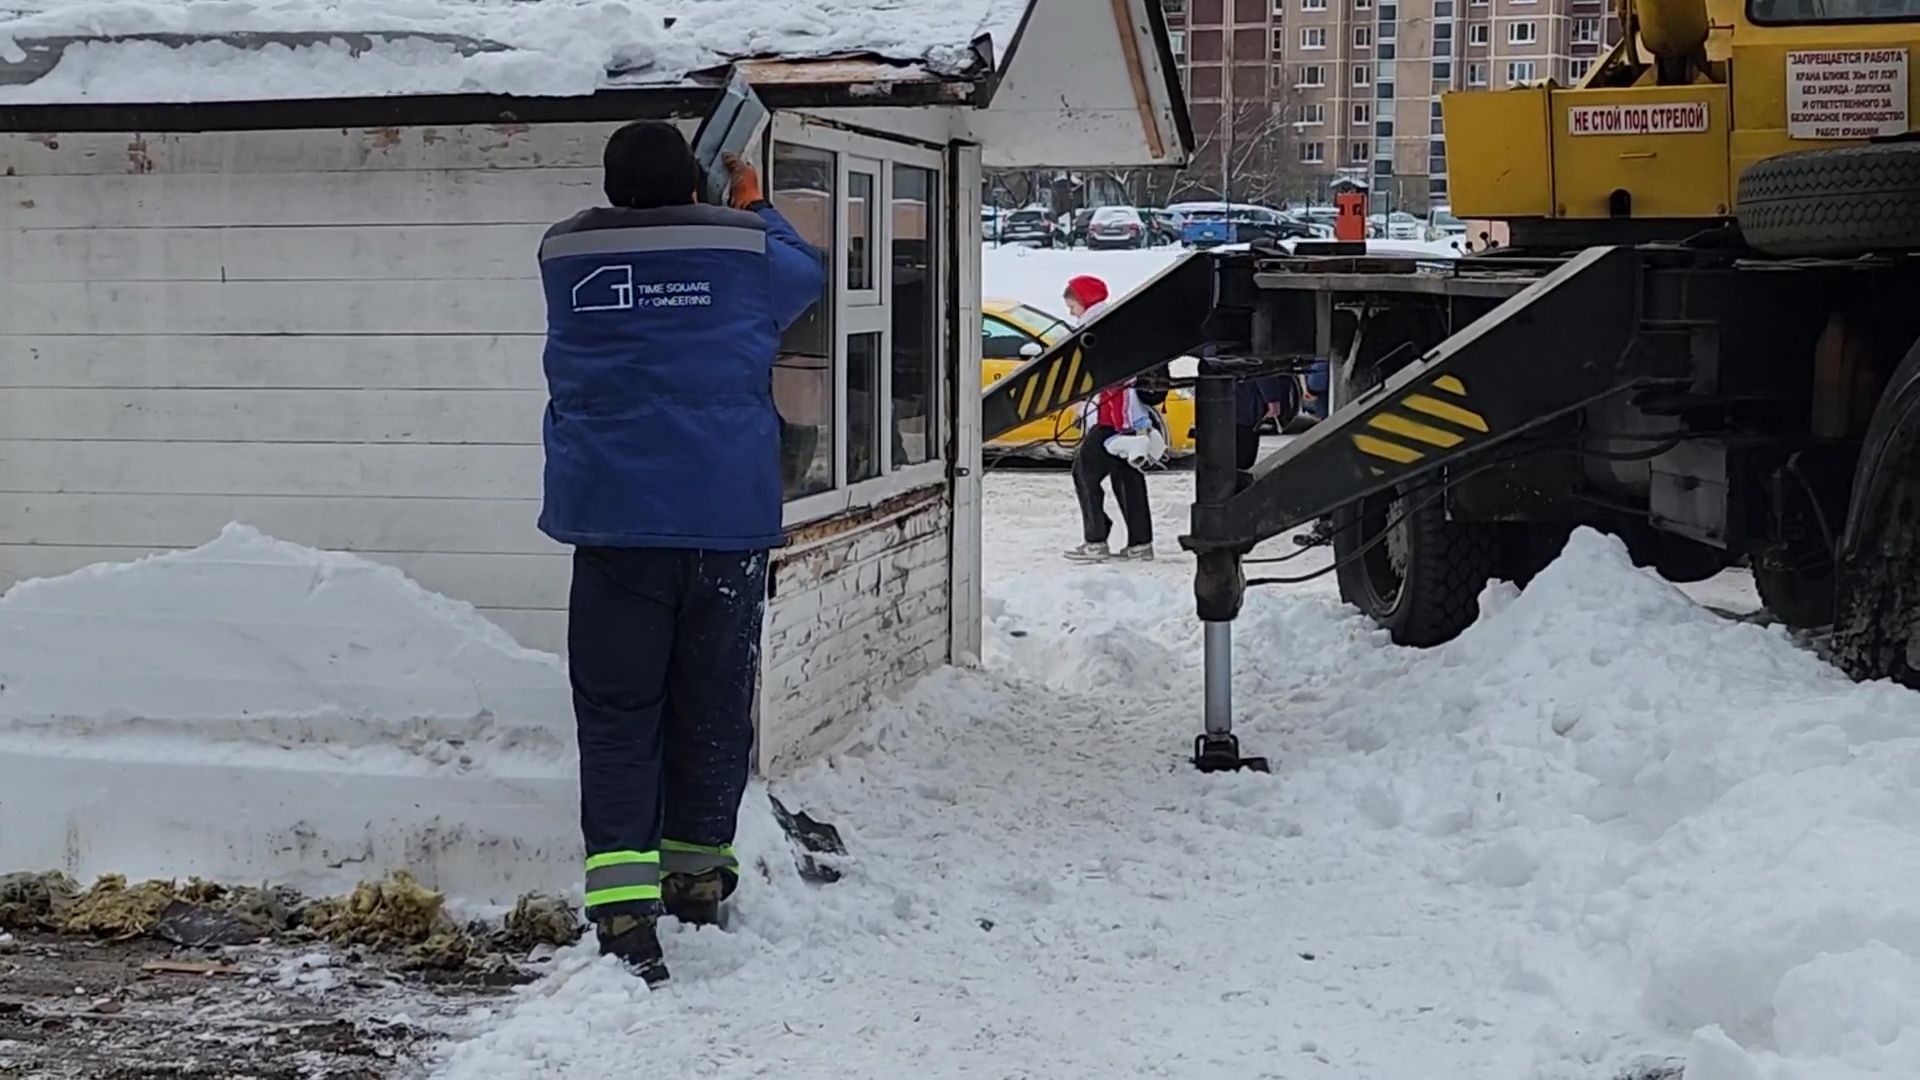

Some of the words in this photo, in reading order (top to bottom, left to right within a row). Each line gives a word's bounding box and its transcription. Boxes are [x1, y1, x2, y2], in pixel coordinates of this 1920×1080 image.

[1864, 51, 1903, 63] РАБОТА
[1796, 71, 1820, 81] КРАНА
[1823, 70, 1850, 80] БЛИЖЕ
[1868, 70, 1879, 80] ОТ
[1881, 69, 1898, 79] ЛЭП
[1802, 85, 1816, 95] БЕЗ
[1818, 84, 1849, 95] НАРЯДА
[1854, 83, 1891, 94] ДОПУСКА
[1802, 100, 1809, 109] И
[1810, 99, 1879, 109] ОТВЕТСТВЕННОГО
[1882, 98, 1892, 108] ЗА
[1574, 111, 1589, 131] НЕ
[1592, 105, 1621, 130] СТОЙ
[1624, 109, 1649, 133] ПОД
[1651, 103, 1704, 129] СТРЕЛОЙ
[1791, 112, 1840, 122] БЕЗОПАСНОЕ
[1842, 111, 1905, 122] ПРОИЗВОДСТВО
[1815, 127, 1840, 137] РАБОТ
[1842, 127, 1879, 136] КРАНАМИ
[637, 283, 664, 295] TIME
[666, 281, 710, 293] SQUARE
